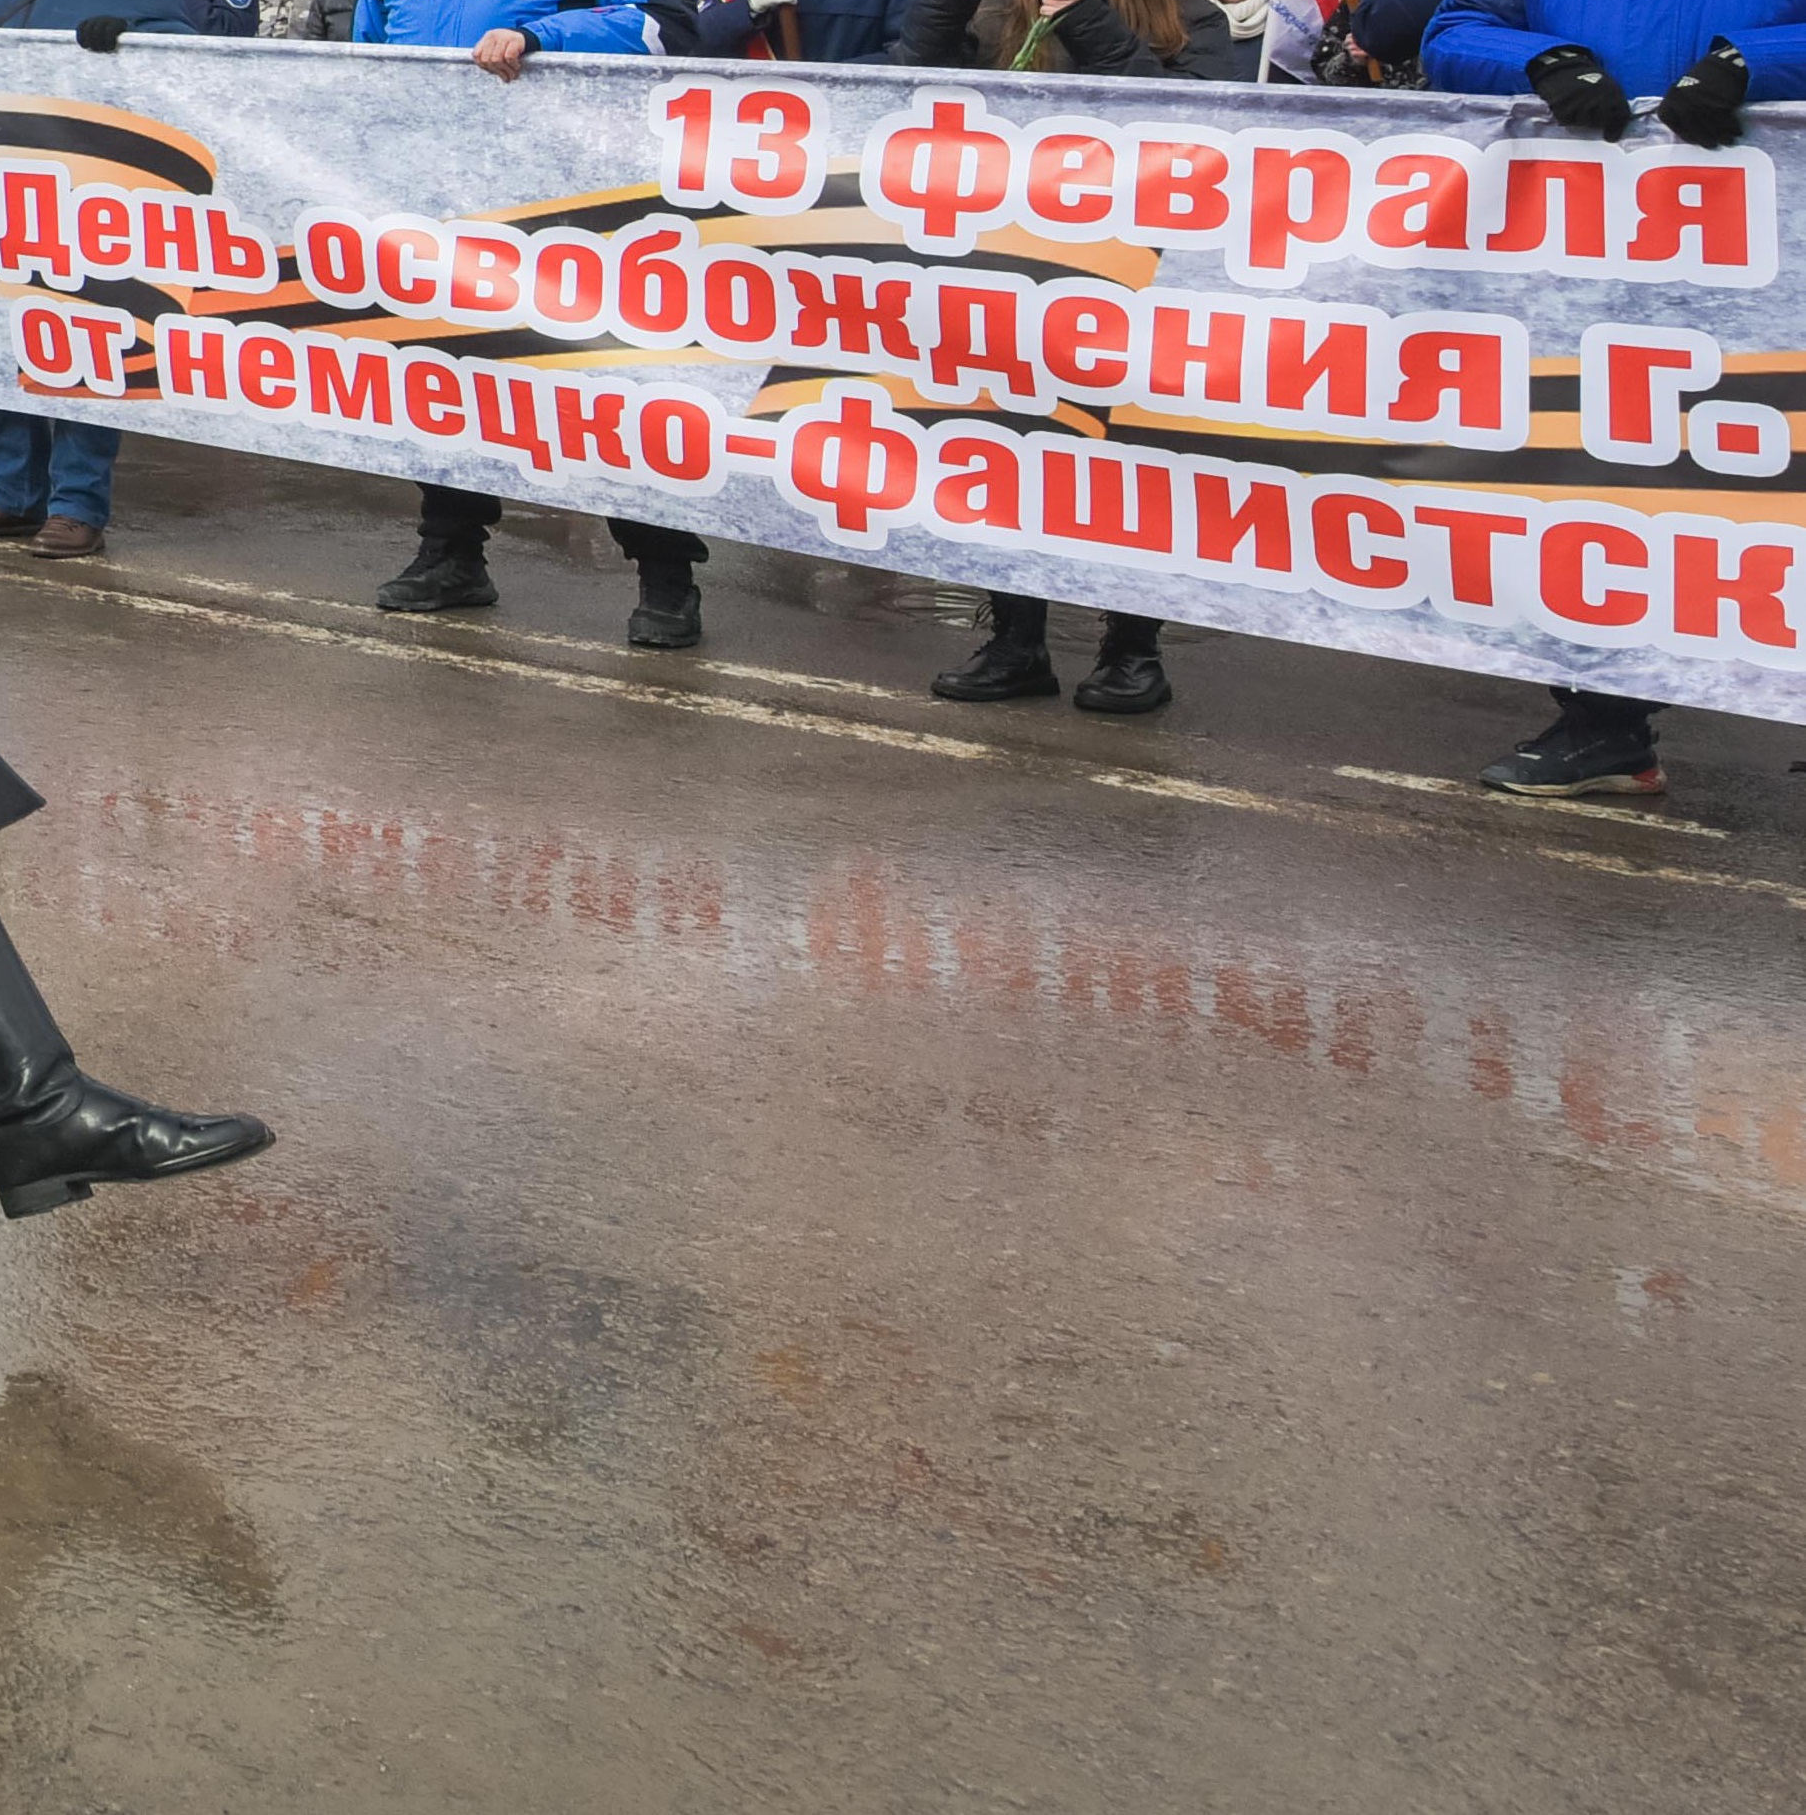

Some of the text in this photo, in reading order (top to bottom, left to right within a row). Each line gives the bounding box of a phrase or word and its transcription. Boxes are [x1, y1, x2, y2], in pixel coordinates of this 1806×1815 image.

[666, 88, 1749, 270] 13 февраля
[308, 221, 1502, 431] освобождения
[22, 308, 1798, 651] от немецко-фашистск
